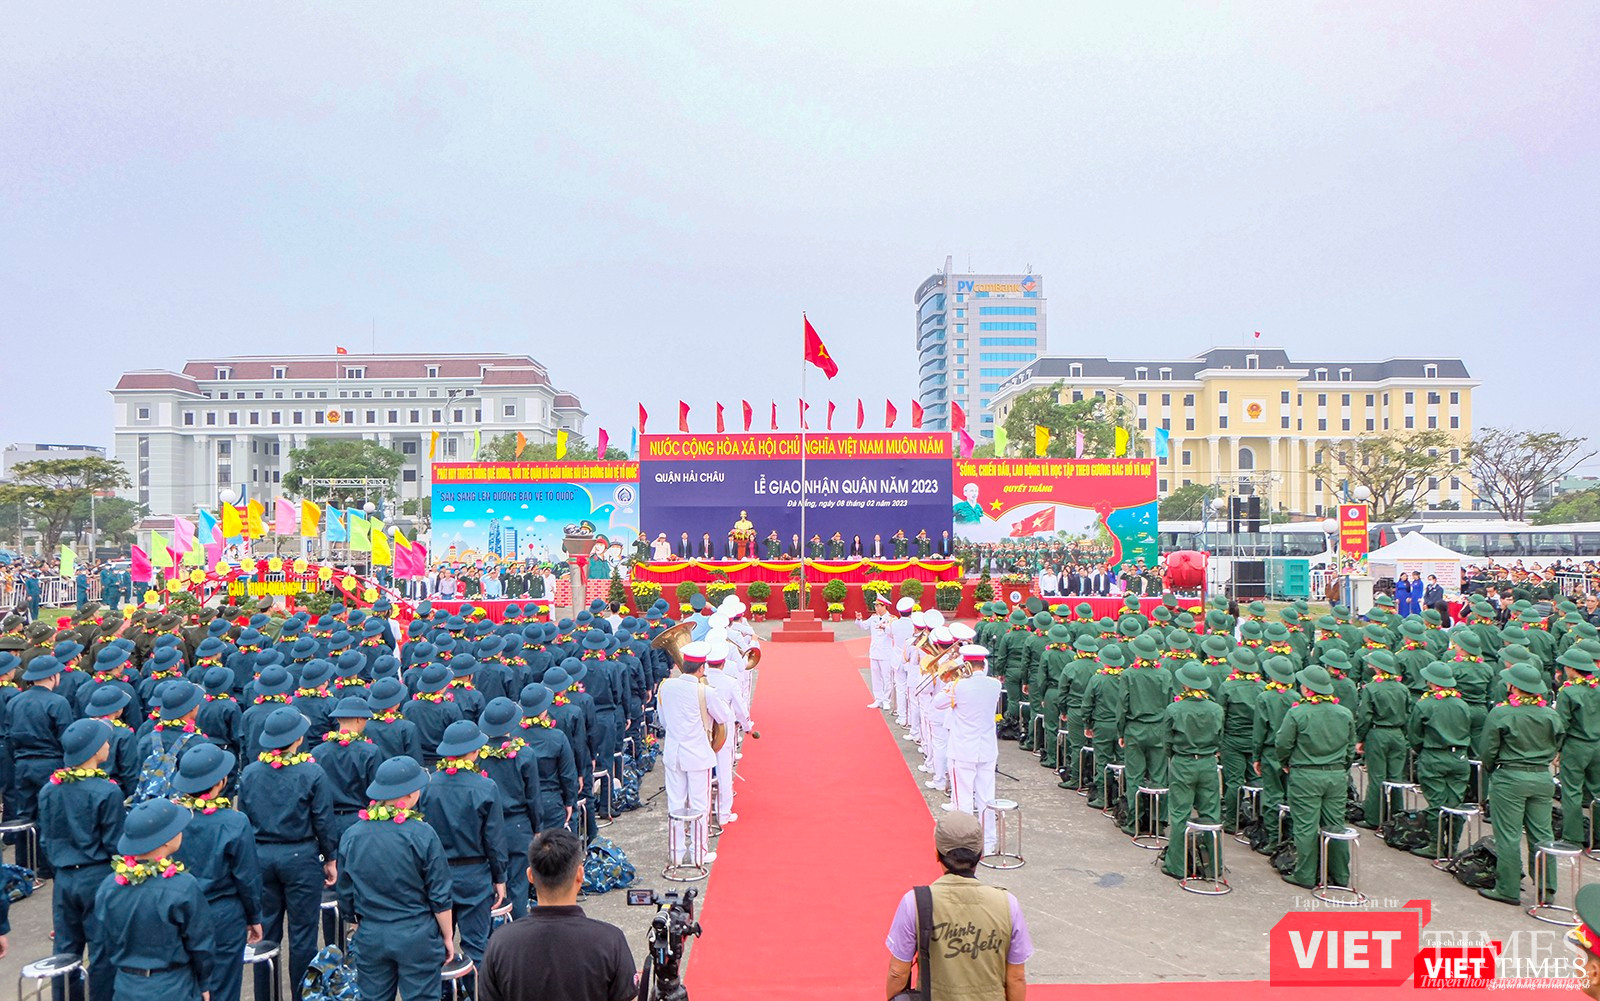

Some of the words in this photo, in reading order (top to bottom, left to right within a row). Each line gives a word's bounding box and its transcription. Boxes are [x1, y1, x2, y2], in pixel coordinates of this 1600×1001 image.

[957, 280, 1021, 293] PVcomBank
[649, 437, 680, 456] NƯỚC
[682, 438, 715, 459] CỘNG
[717, 436, 740, 456] HÒA
[741, 437, 756, 455] XÃ
[758, 437, 777, 458] HỘI
[779, 435, 800, 455] CHỦ
[804, 437, 836, 455] NGHĨA
[838, 437, 857, 457] VIỆT
[859, 439, 884, 454] NAM
[886, 437, 917, 454] MUÔN
[919, 436, 944, 454] NĂM
[655, 470, 681, 484] QUẬN
[683, 470, 698, 482] HẢI
[700, 471, 725, 483] CHÂU
[1075, 464, 1091, 477] THEO
[754, 474, 766, 494] LỄ
[769, 480, 801, 494] GIAO
[804, 477, 839, 496] NHẬN
[842, 477, 877, 494] QUÂN
[879, 476, 909, 494] NĂM
[911, 479, 939, 494] 2023
[1003, 483, 1027, 494] QUYẾT
[1028, 483, 1053, 493] THẮNG
[787, 499, 797, 507] Đà
[818, 500, 837, 509] ngày
[836, 499, 846, 507] 08
[846, 500, 866, 509] tháng
[892, 499, 909, 507] 2023
[931, 921, 977, 942] Think
[943, 929, 1003, 960] Safety
